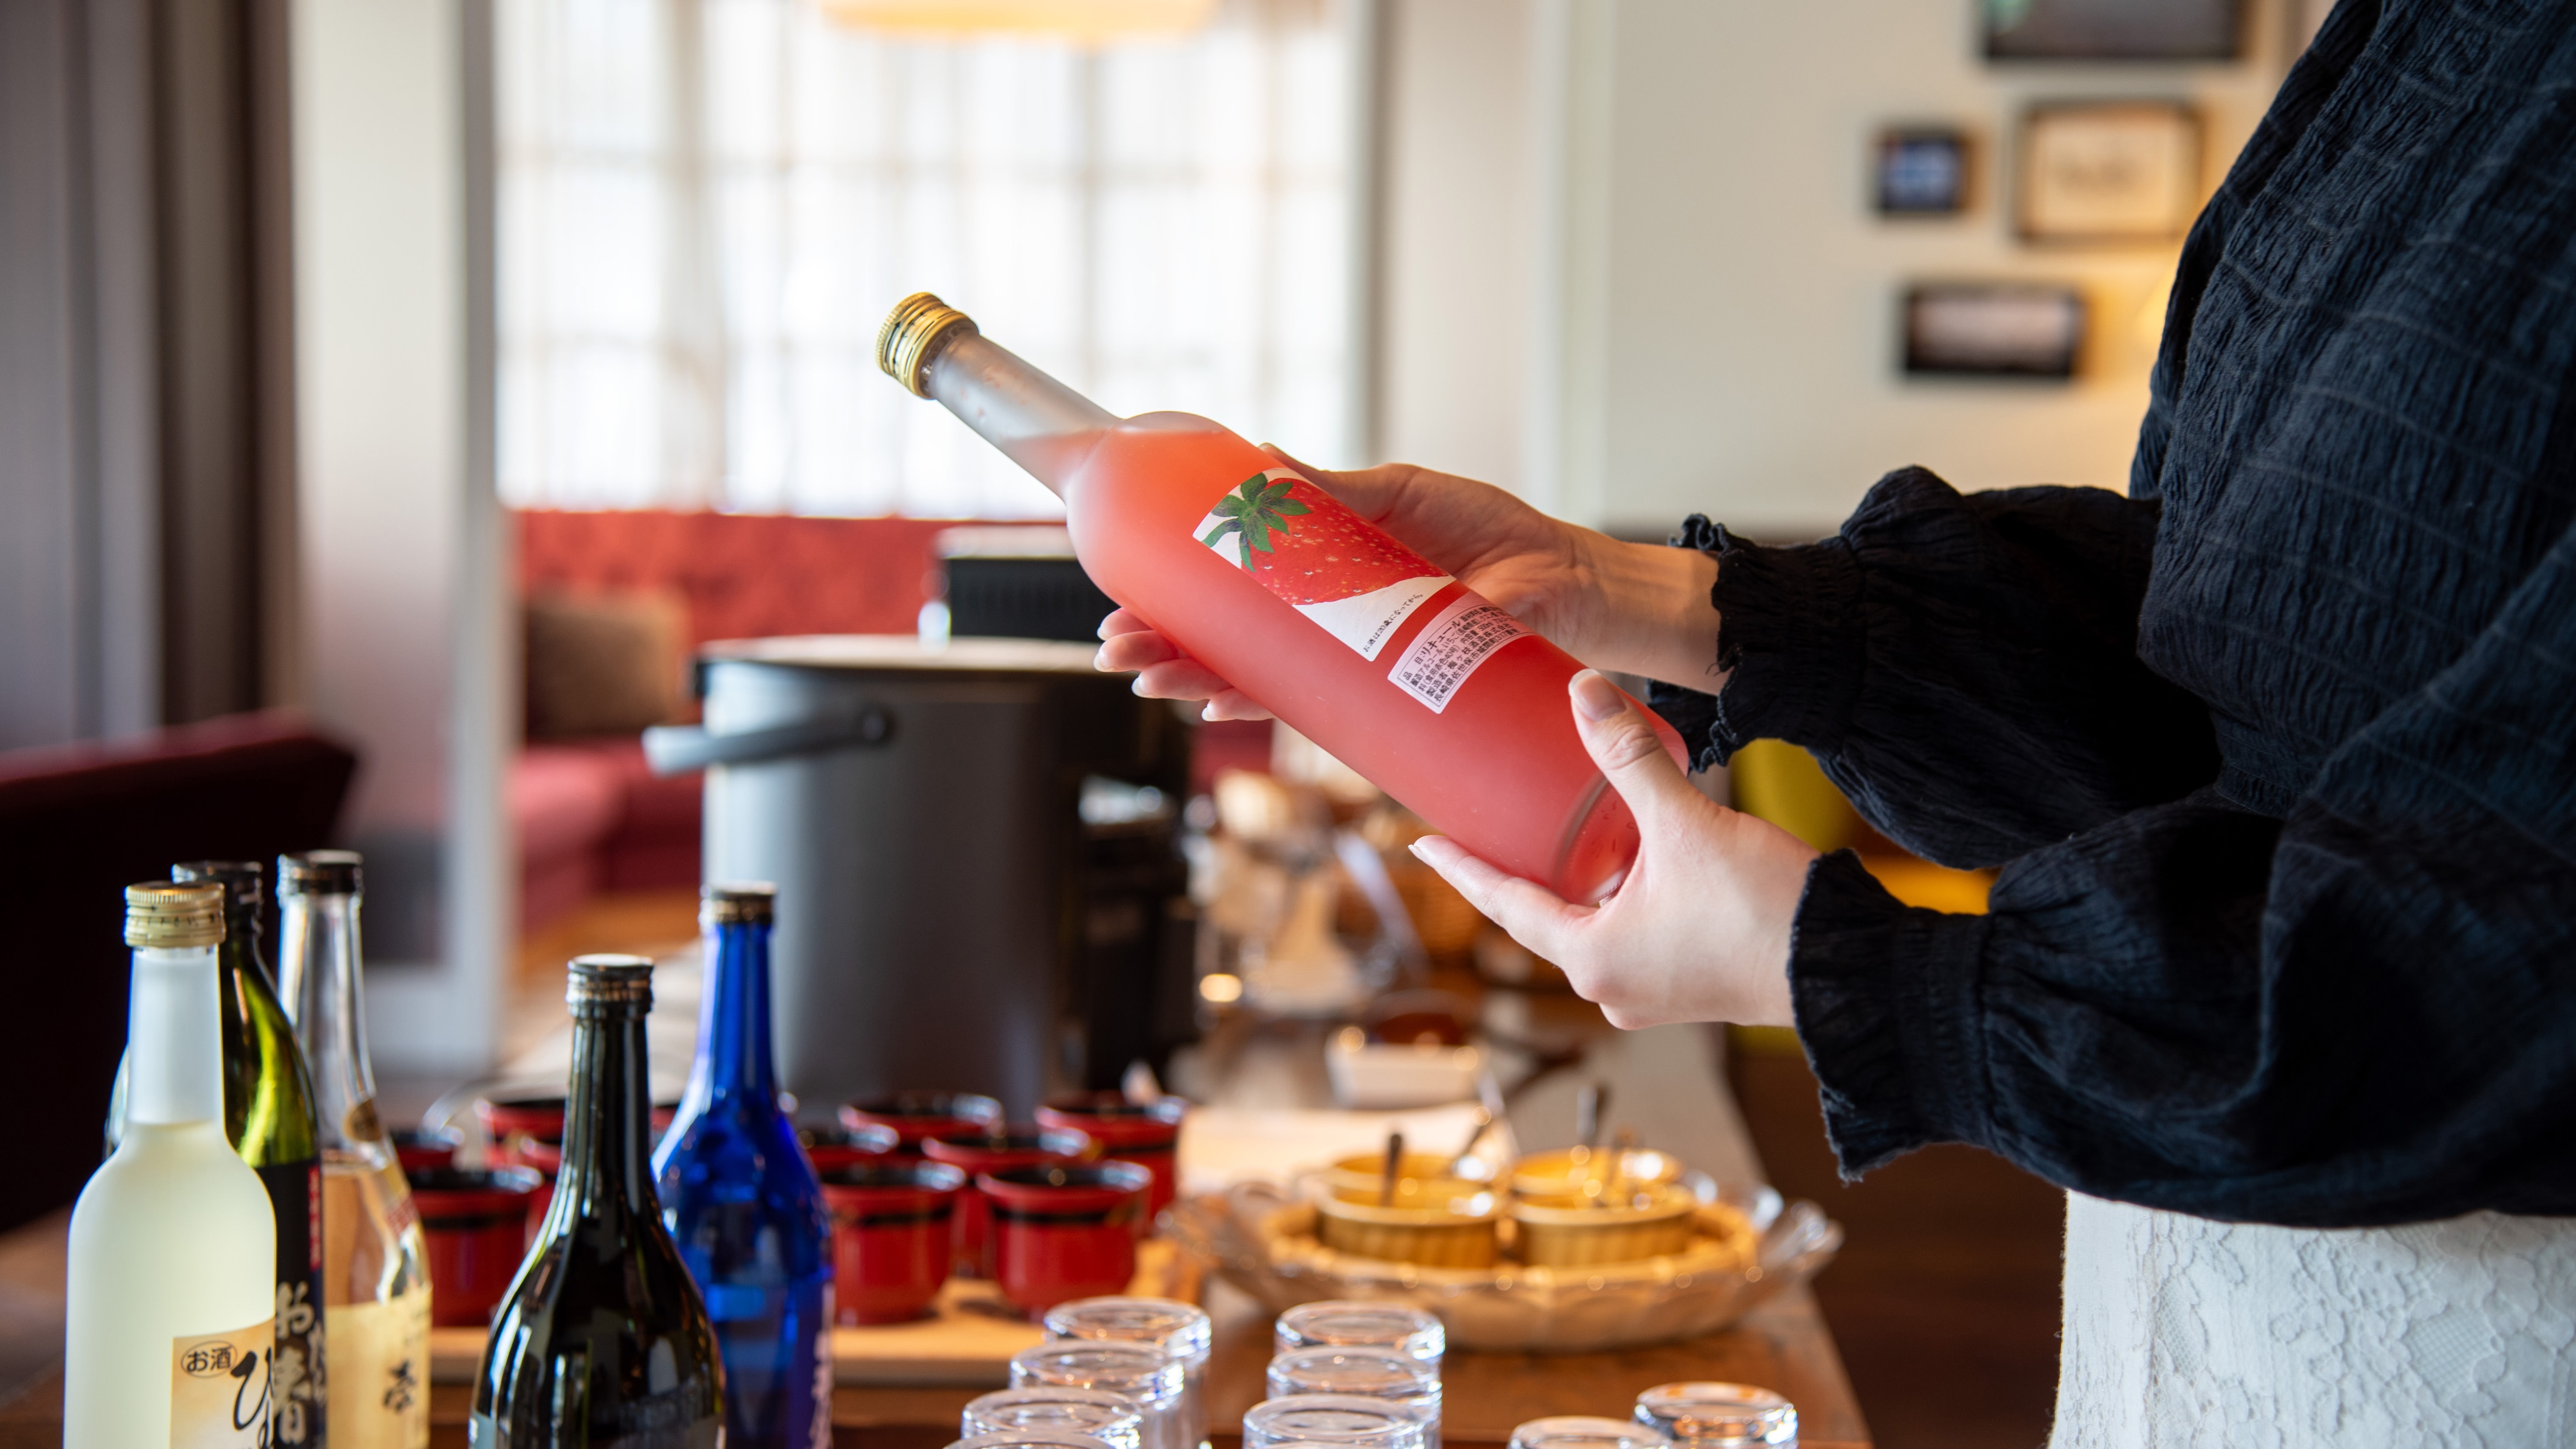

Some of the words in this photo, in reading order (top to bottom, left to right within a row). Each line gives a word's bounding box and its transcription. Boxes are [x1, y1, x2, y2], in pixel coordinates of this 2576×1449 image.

[1363, 594, 1423, 652] お酒は20歳になってから。
[187, 1346, 233, 1372] お酒
